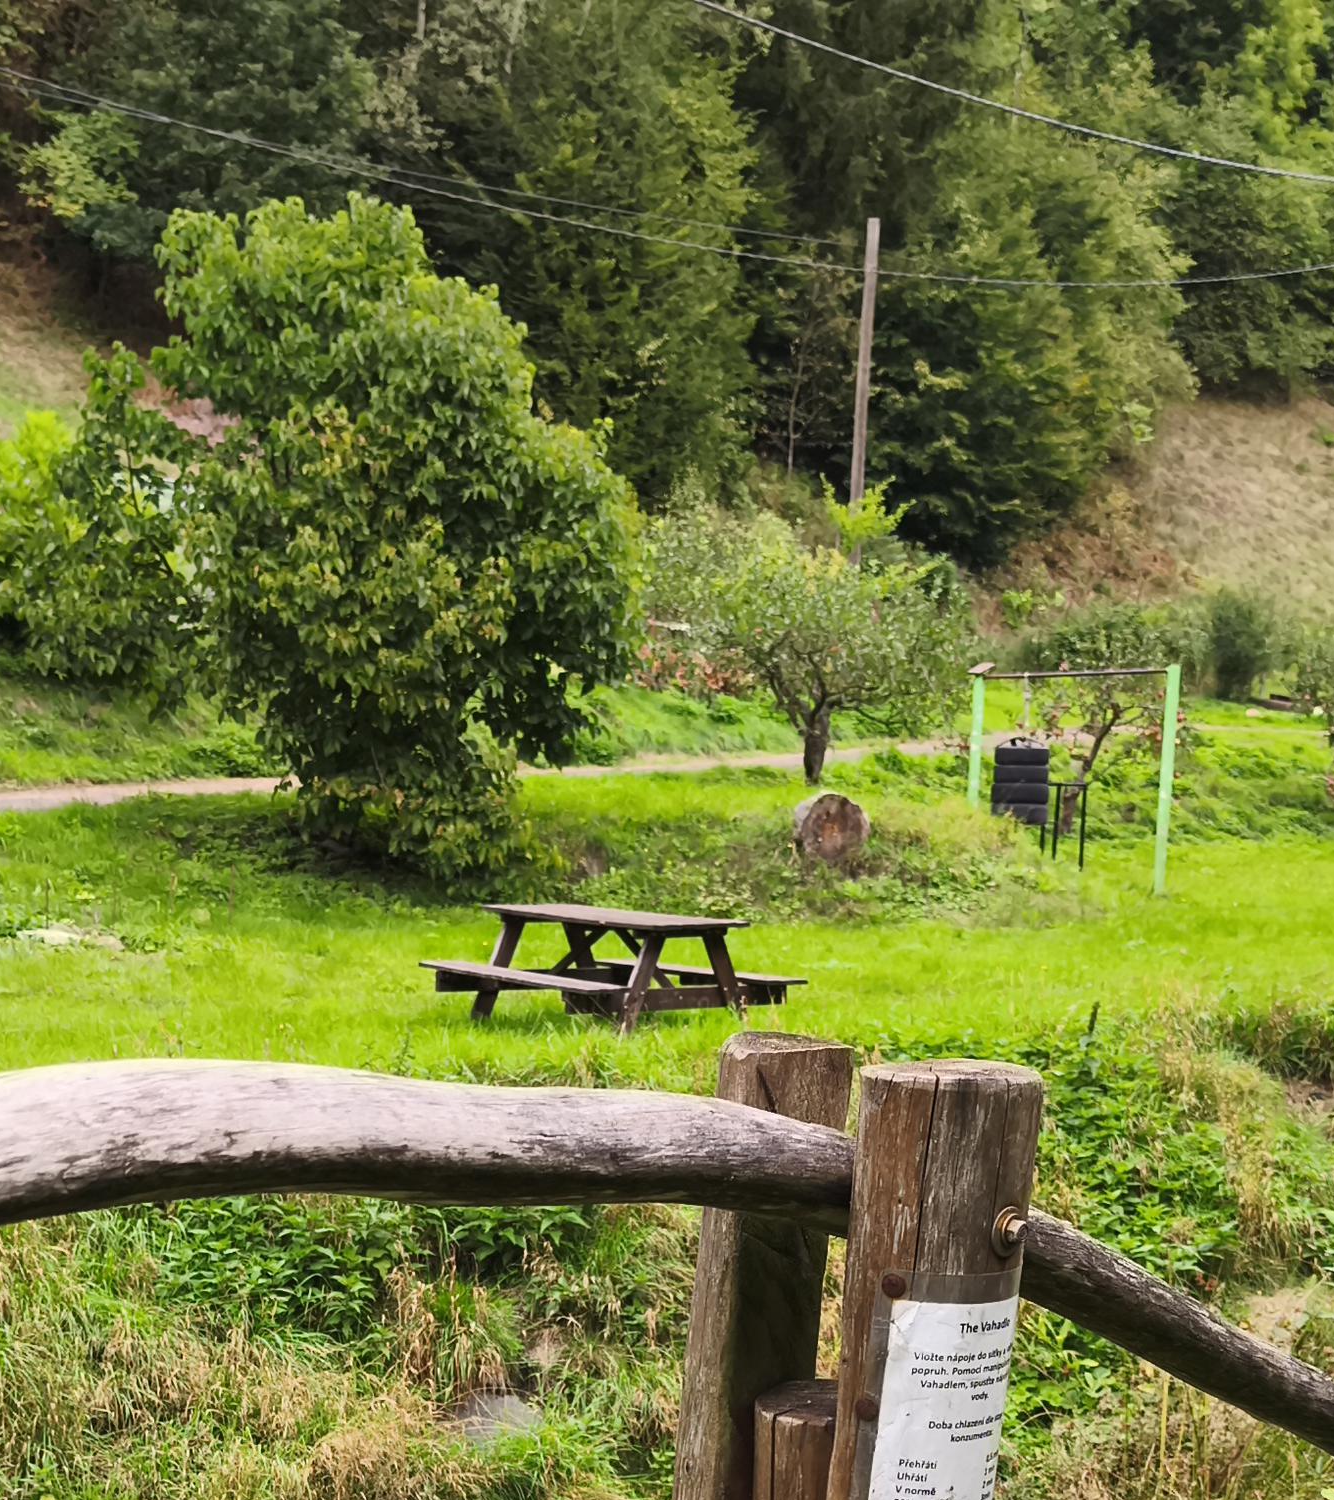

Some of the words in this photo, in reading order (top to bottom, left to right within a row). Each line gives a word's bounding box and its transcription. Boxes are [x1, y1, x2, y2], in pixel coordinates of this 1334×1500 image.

[959, 1323, 978, 1334] The
[914, 1351, 944, 1362] Vložte
[946, 1352, 976, 1364] nápoje
[977, 1351, 987, 1361] do
[911, 1366, 949, 1376] popruh.
[951, 1364, 982, 1376] Pomocí
[920, 1380, 968, 1390] Vahadlem,
[928, 1421, 953, 1430] Doba
[954, 1417, 985, 1429] chlazení
[898, 1458, 938, 1470] Přehřátí
[896, 1471, 928, 1482] Uhřátí
[895, 1485, 903, 1494] V
[904, 1487, 937, 1496] normě
